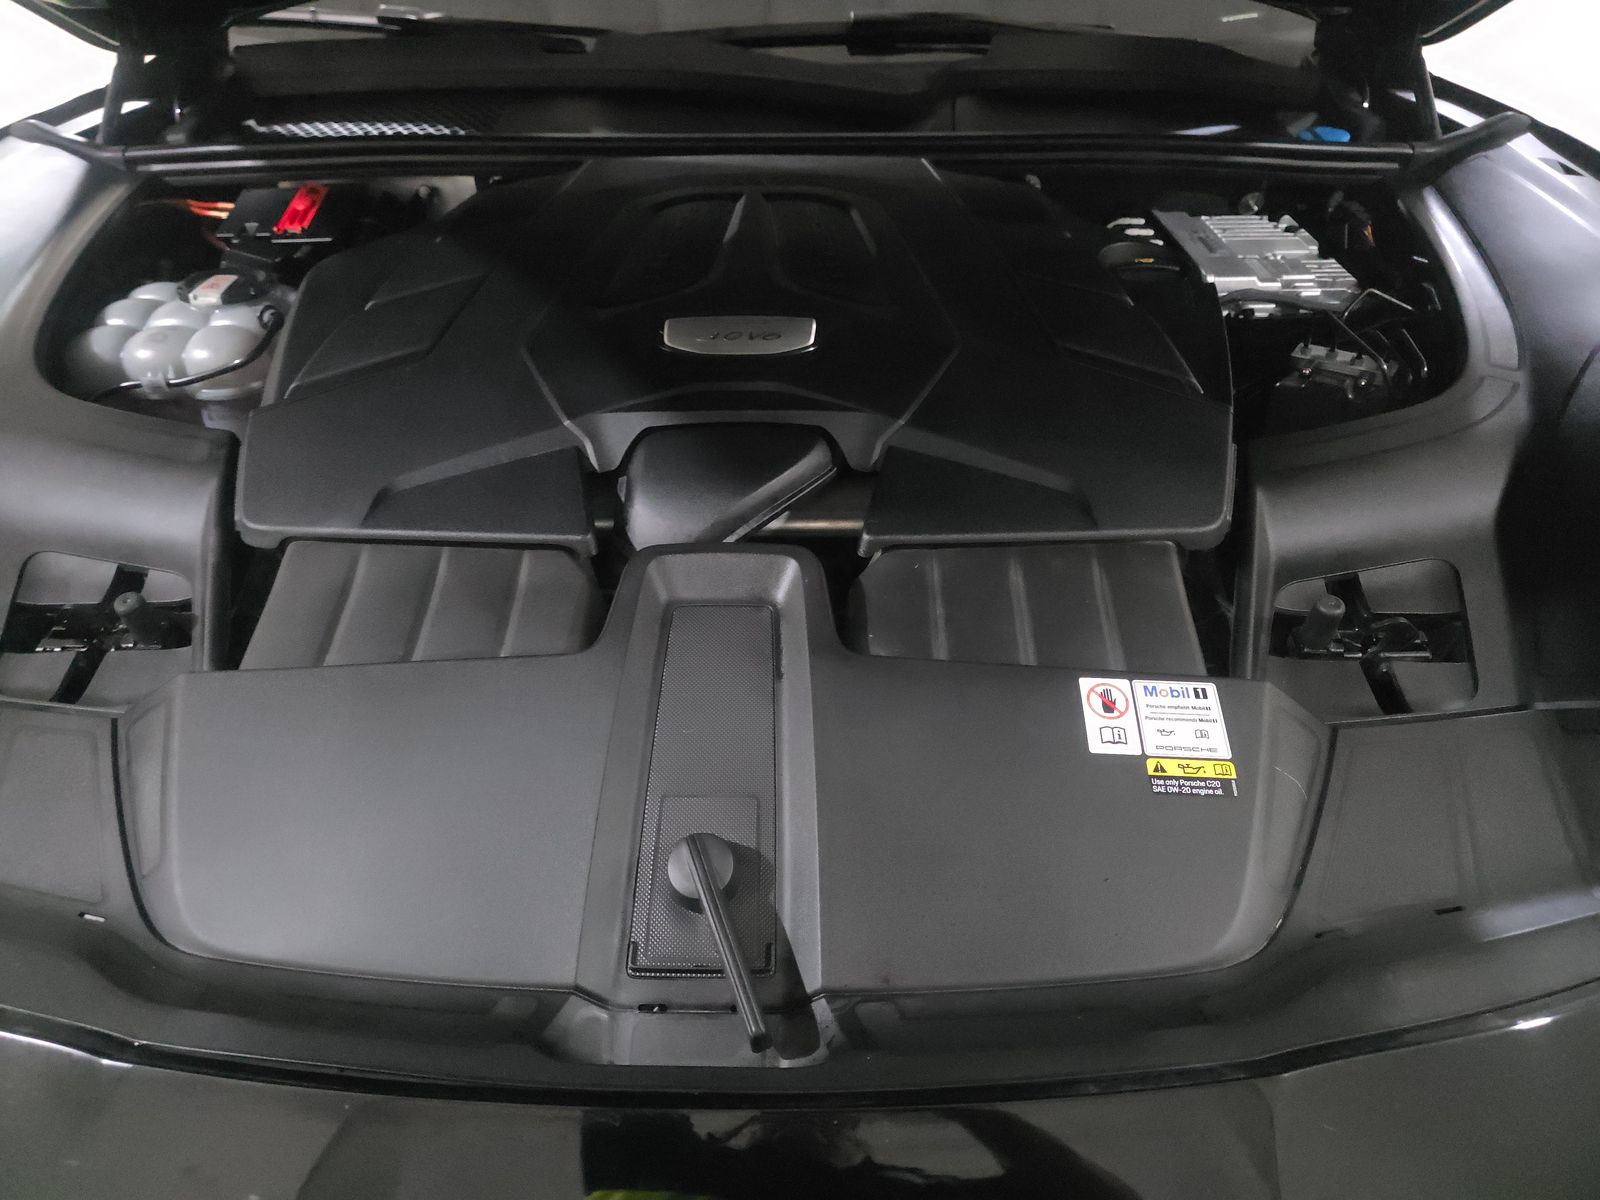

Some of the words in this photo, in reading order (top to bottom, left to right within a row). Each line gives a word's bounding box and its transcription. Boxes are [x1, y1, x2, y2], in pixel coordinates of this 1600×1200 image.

[1143, 685, 1190, 698] Mobil
[1193, 687, 1208, 699] 1
[1155, 745, 1218, 753] PORSCHE
[1151, 778, 1165, 786] Use
[1165, 779, 1179, 787] only
[1179, 779, 1206, 787] Porsche
[1206, 780, 1221, 788] C20
[1152, 785, 1167, 793] SAE
[1192, 788, 1214, 796] engine
